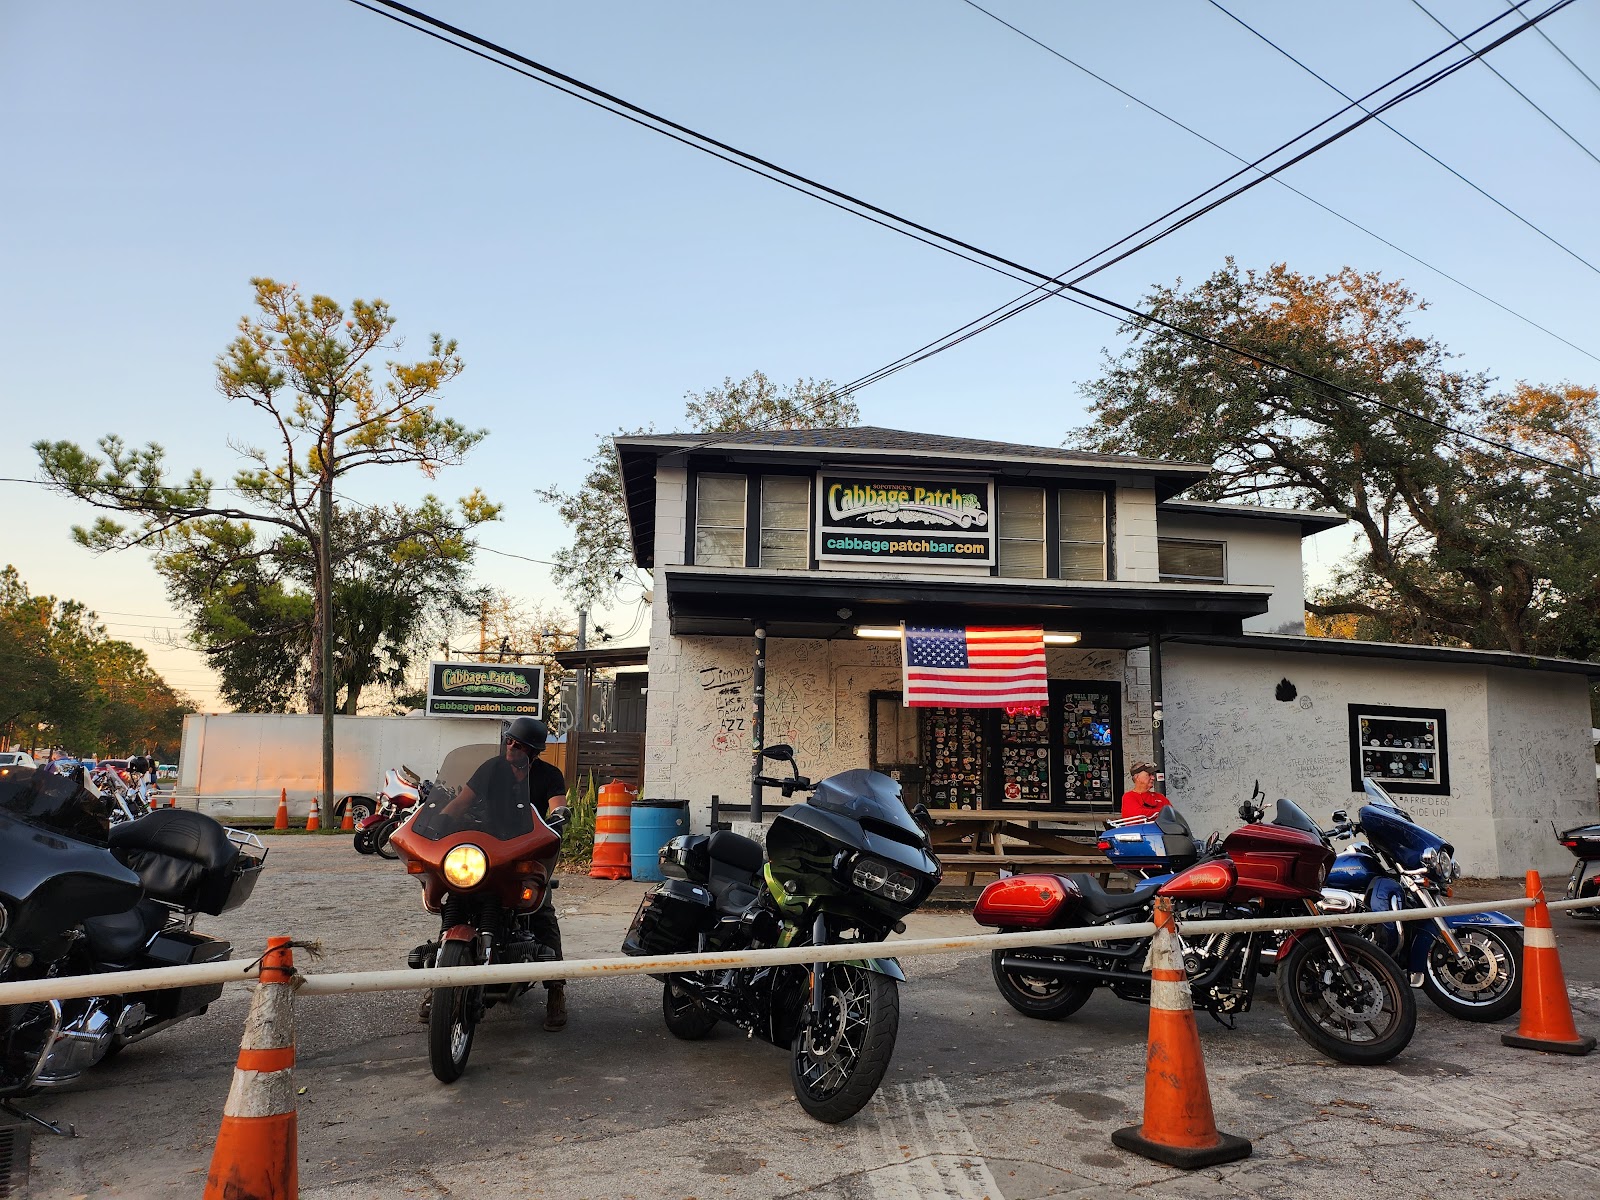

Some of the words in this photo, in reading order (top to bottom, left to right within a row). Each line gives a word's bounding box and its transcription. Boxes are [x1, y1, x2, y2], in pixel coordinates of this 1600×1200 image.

[829, 484, 909, 520] Cabbage
[914, 487, 963, 511] Patch
[827, 537, 984, 554] cabbagepatchbar.com
[442, 669, 487, 692] Cabbage
[489, 671, 517, 686] Patch
[700, 667, 755, 690] Jimmy
[433, 702, 536, 713] cabbagepatchbar.com
